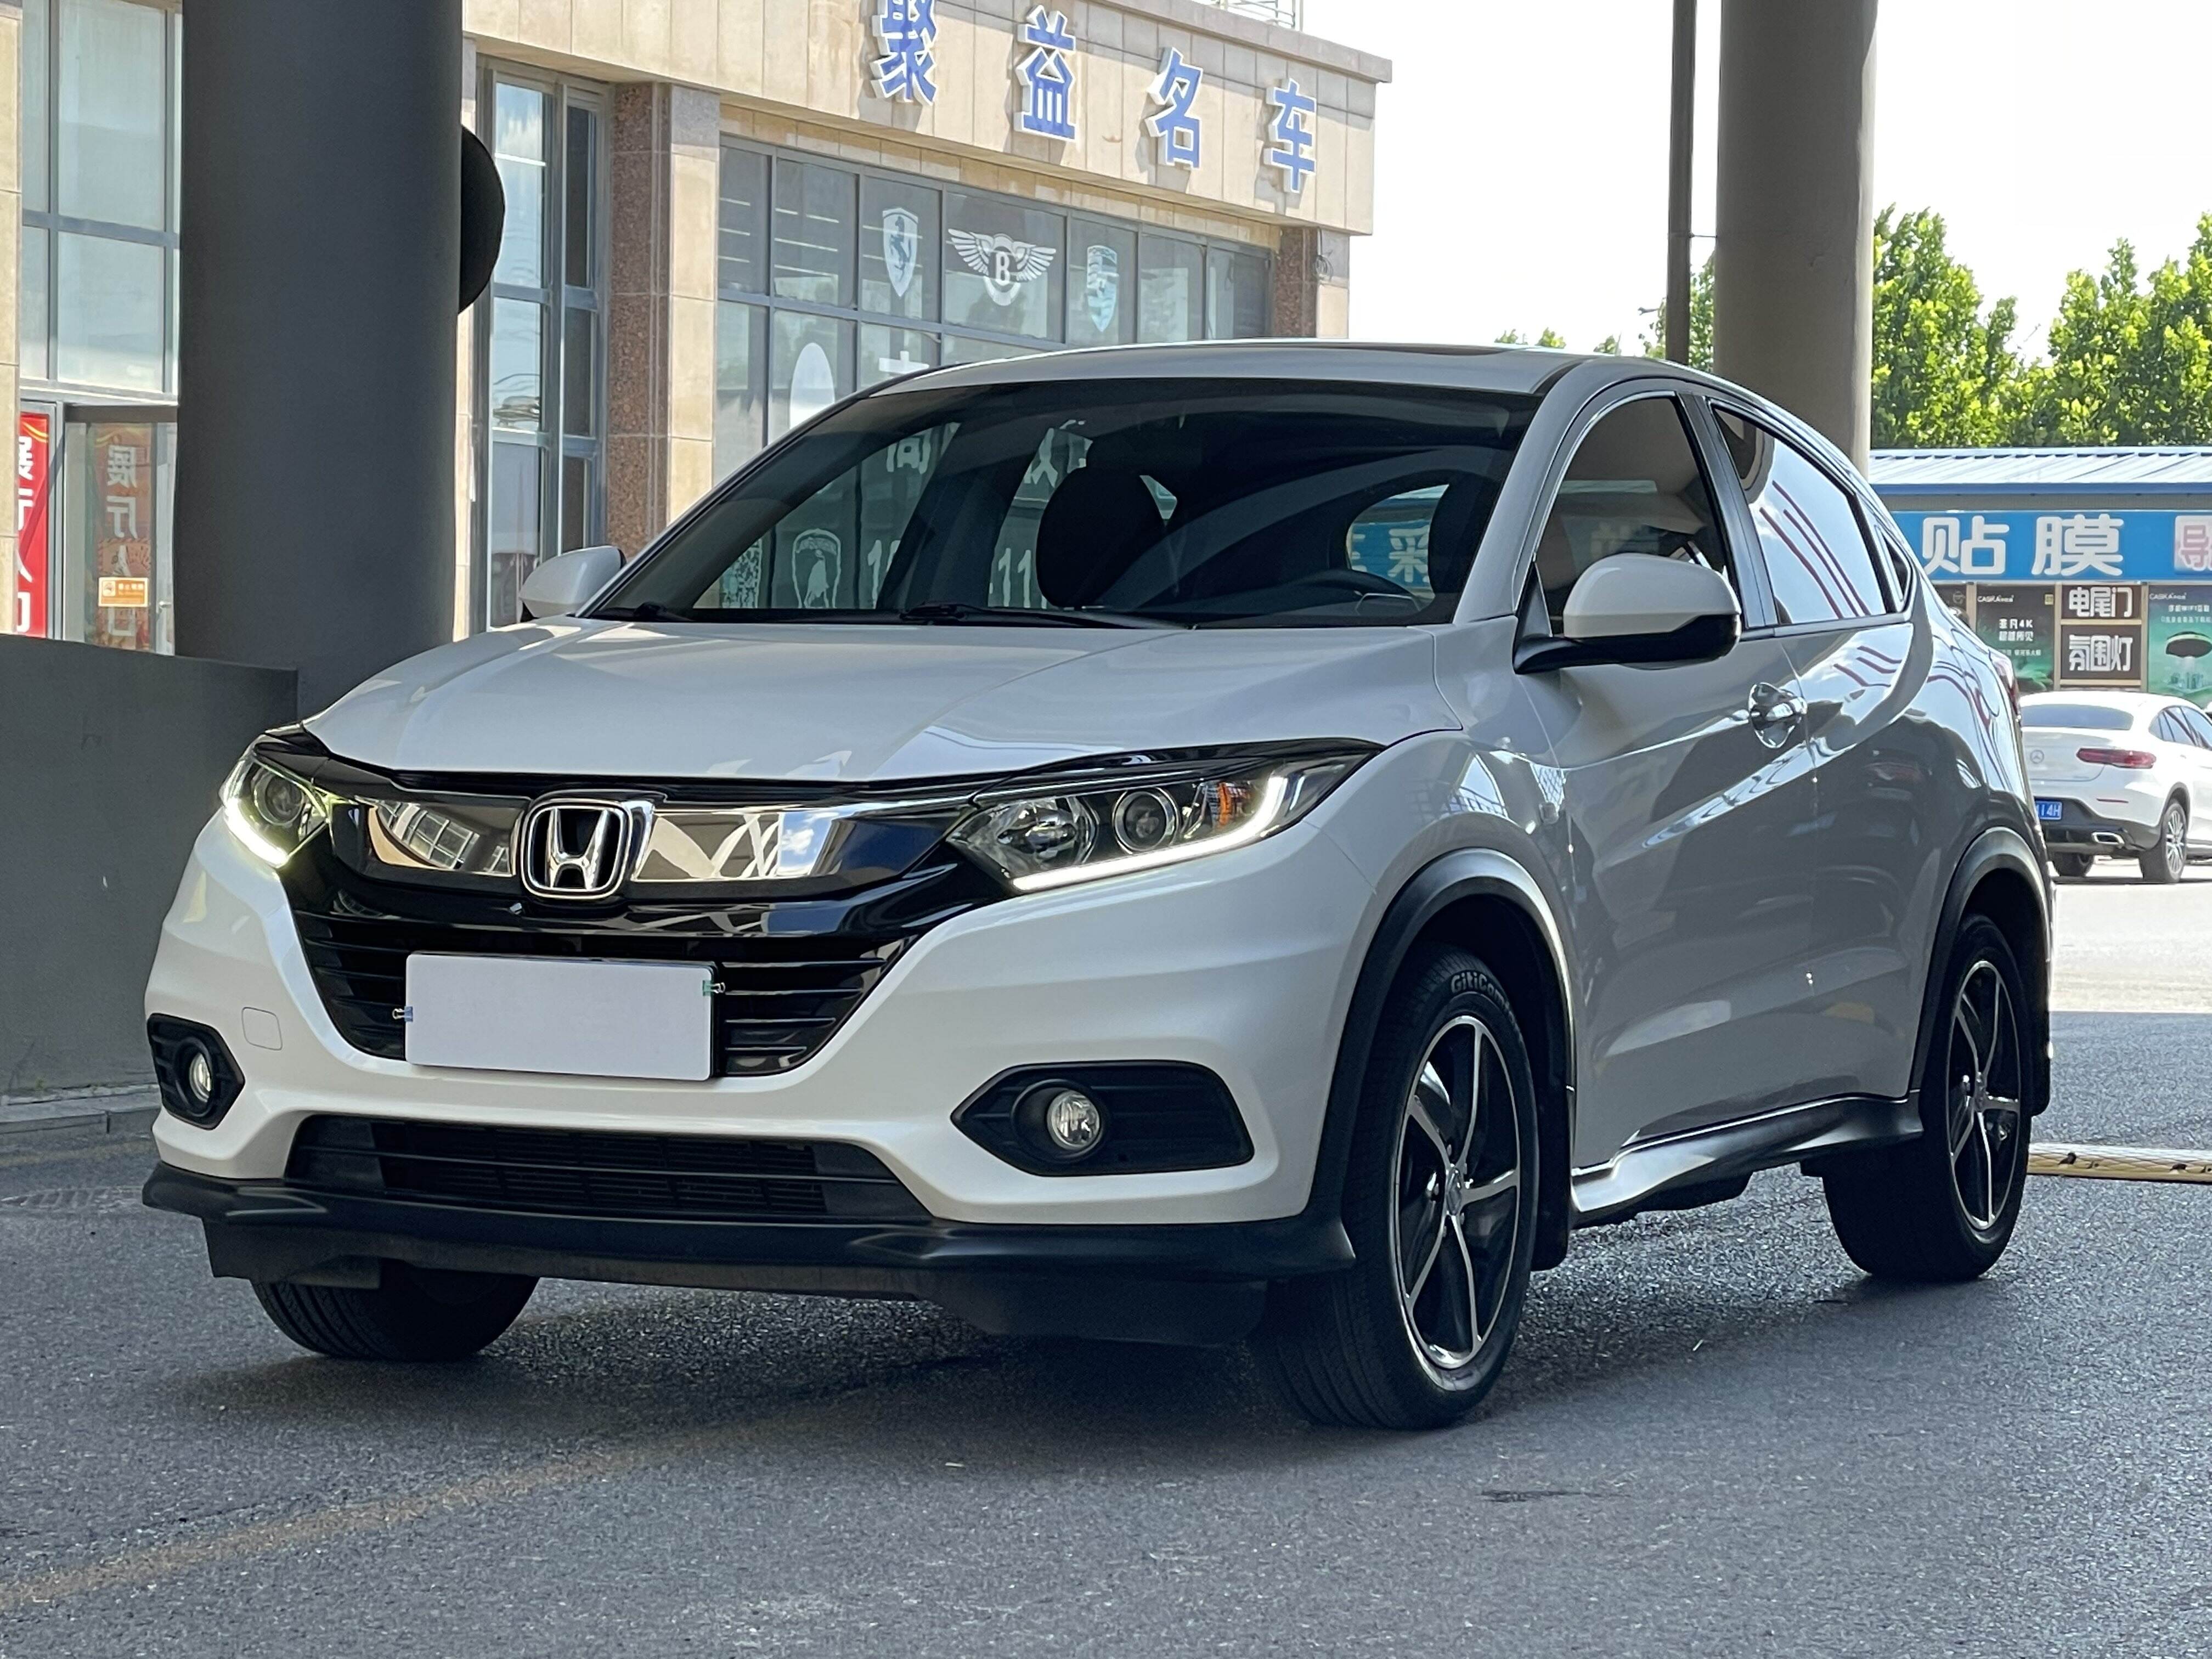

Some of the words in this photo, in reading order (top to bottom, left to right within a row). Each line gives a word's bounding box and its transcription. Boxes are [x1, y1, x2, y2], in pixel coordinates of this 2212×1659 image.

[871, 0, 1316, 193] 聚益名车
[995, 251, 1011, 286] B
[1922, 514, 2124, 577] 贴膜
[2069, 586, 2132, 617] 电尾门
[2069, 635, 2133, 672] 氛围灯
